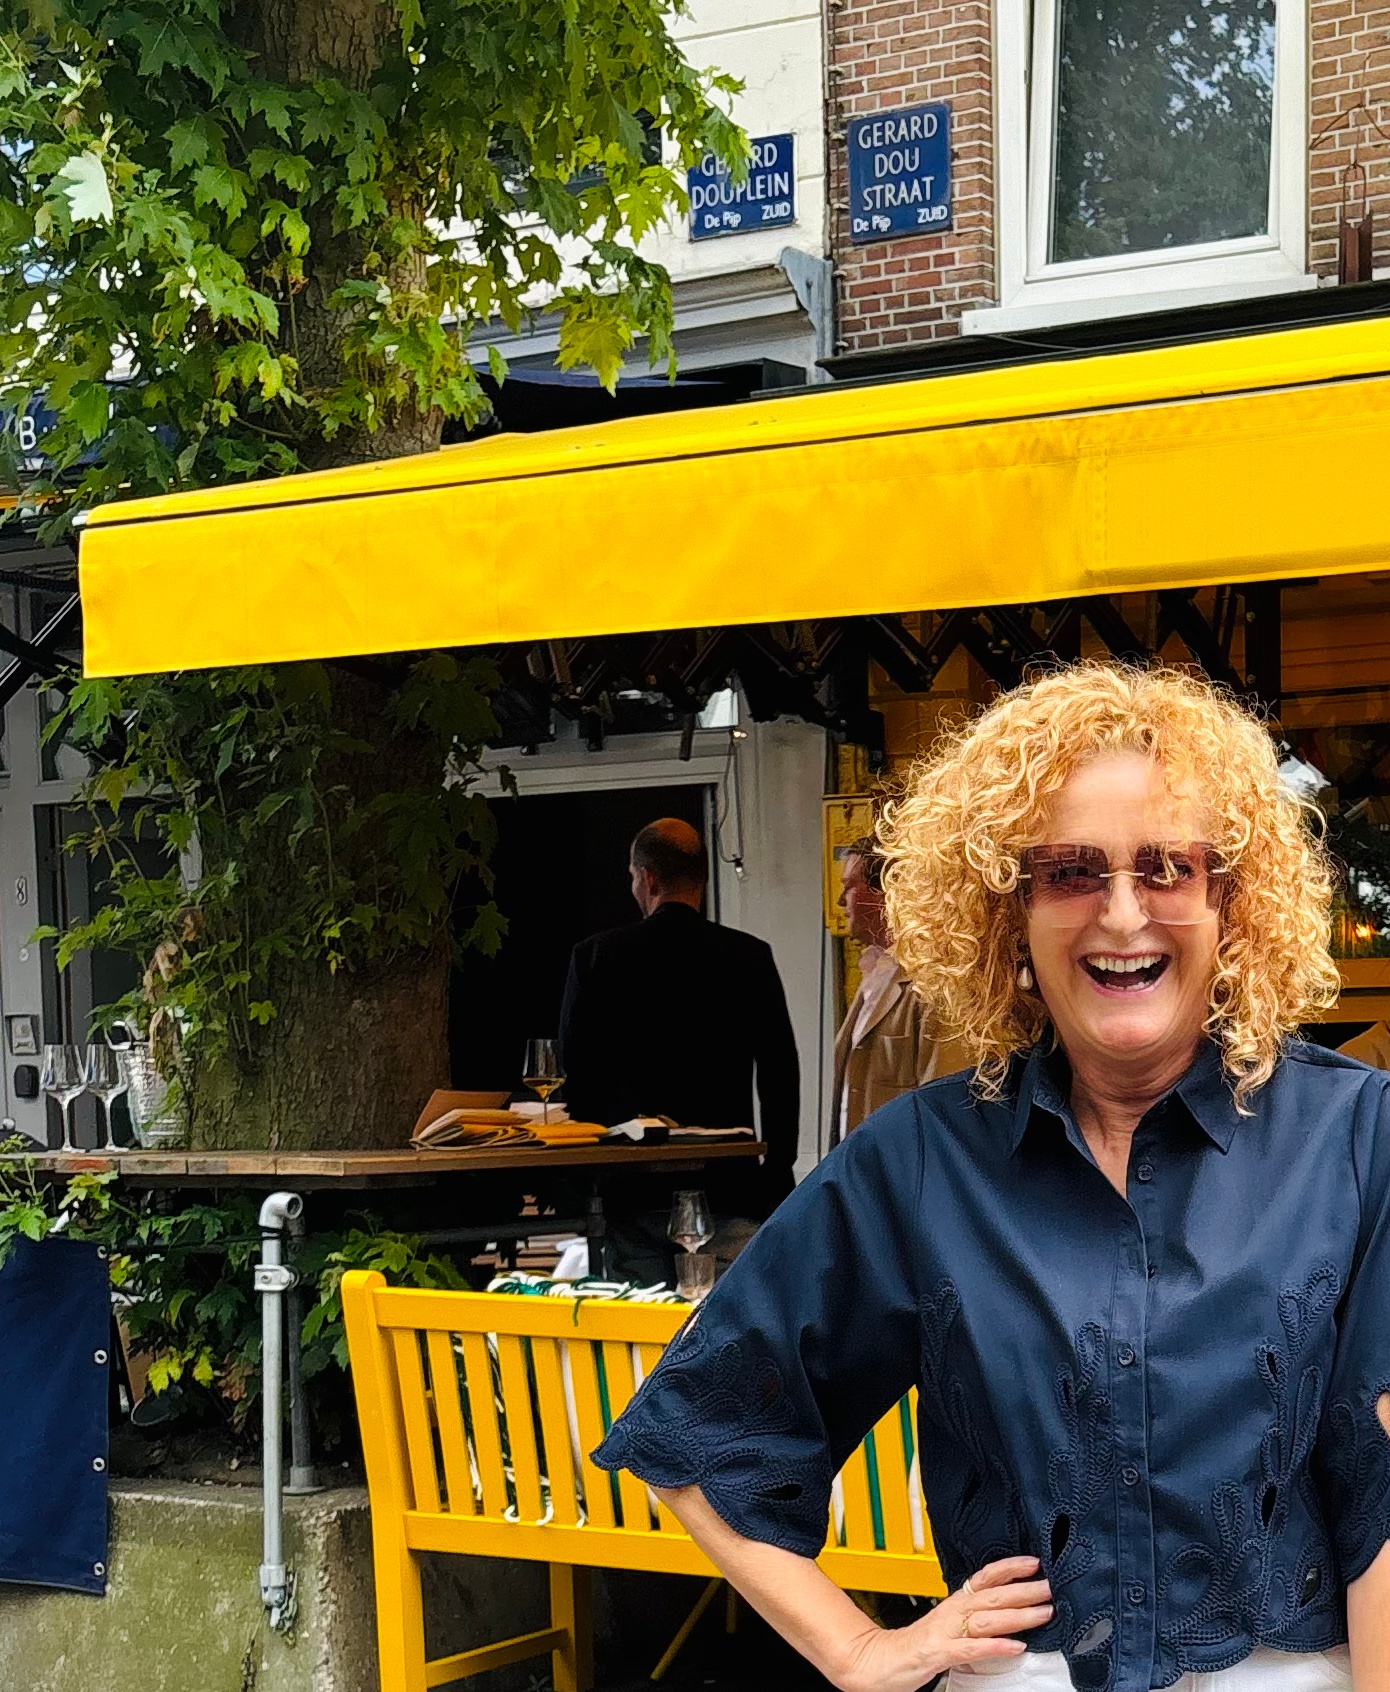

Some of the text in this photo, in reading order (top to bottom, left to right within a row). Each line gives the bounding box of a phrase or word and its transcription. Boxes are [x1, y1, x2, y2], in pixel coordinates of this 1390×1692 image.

[858, 113, 939, 149] GERARD
[701, 142, 778, 177] GERD
[874, 147, 920, 178] DOU
[691, 171, 790, 210] DOUPLEIN
[862, 175, 936, 211] STRAAT
[704, 214, 721, 229] De
[761, 201, 791, 220] ZUID
[853, 218, 870, 233] De
[917, 205, 948, 224] ZUID
